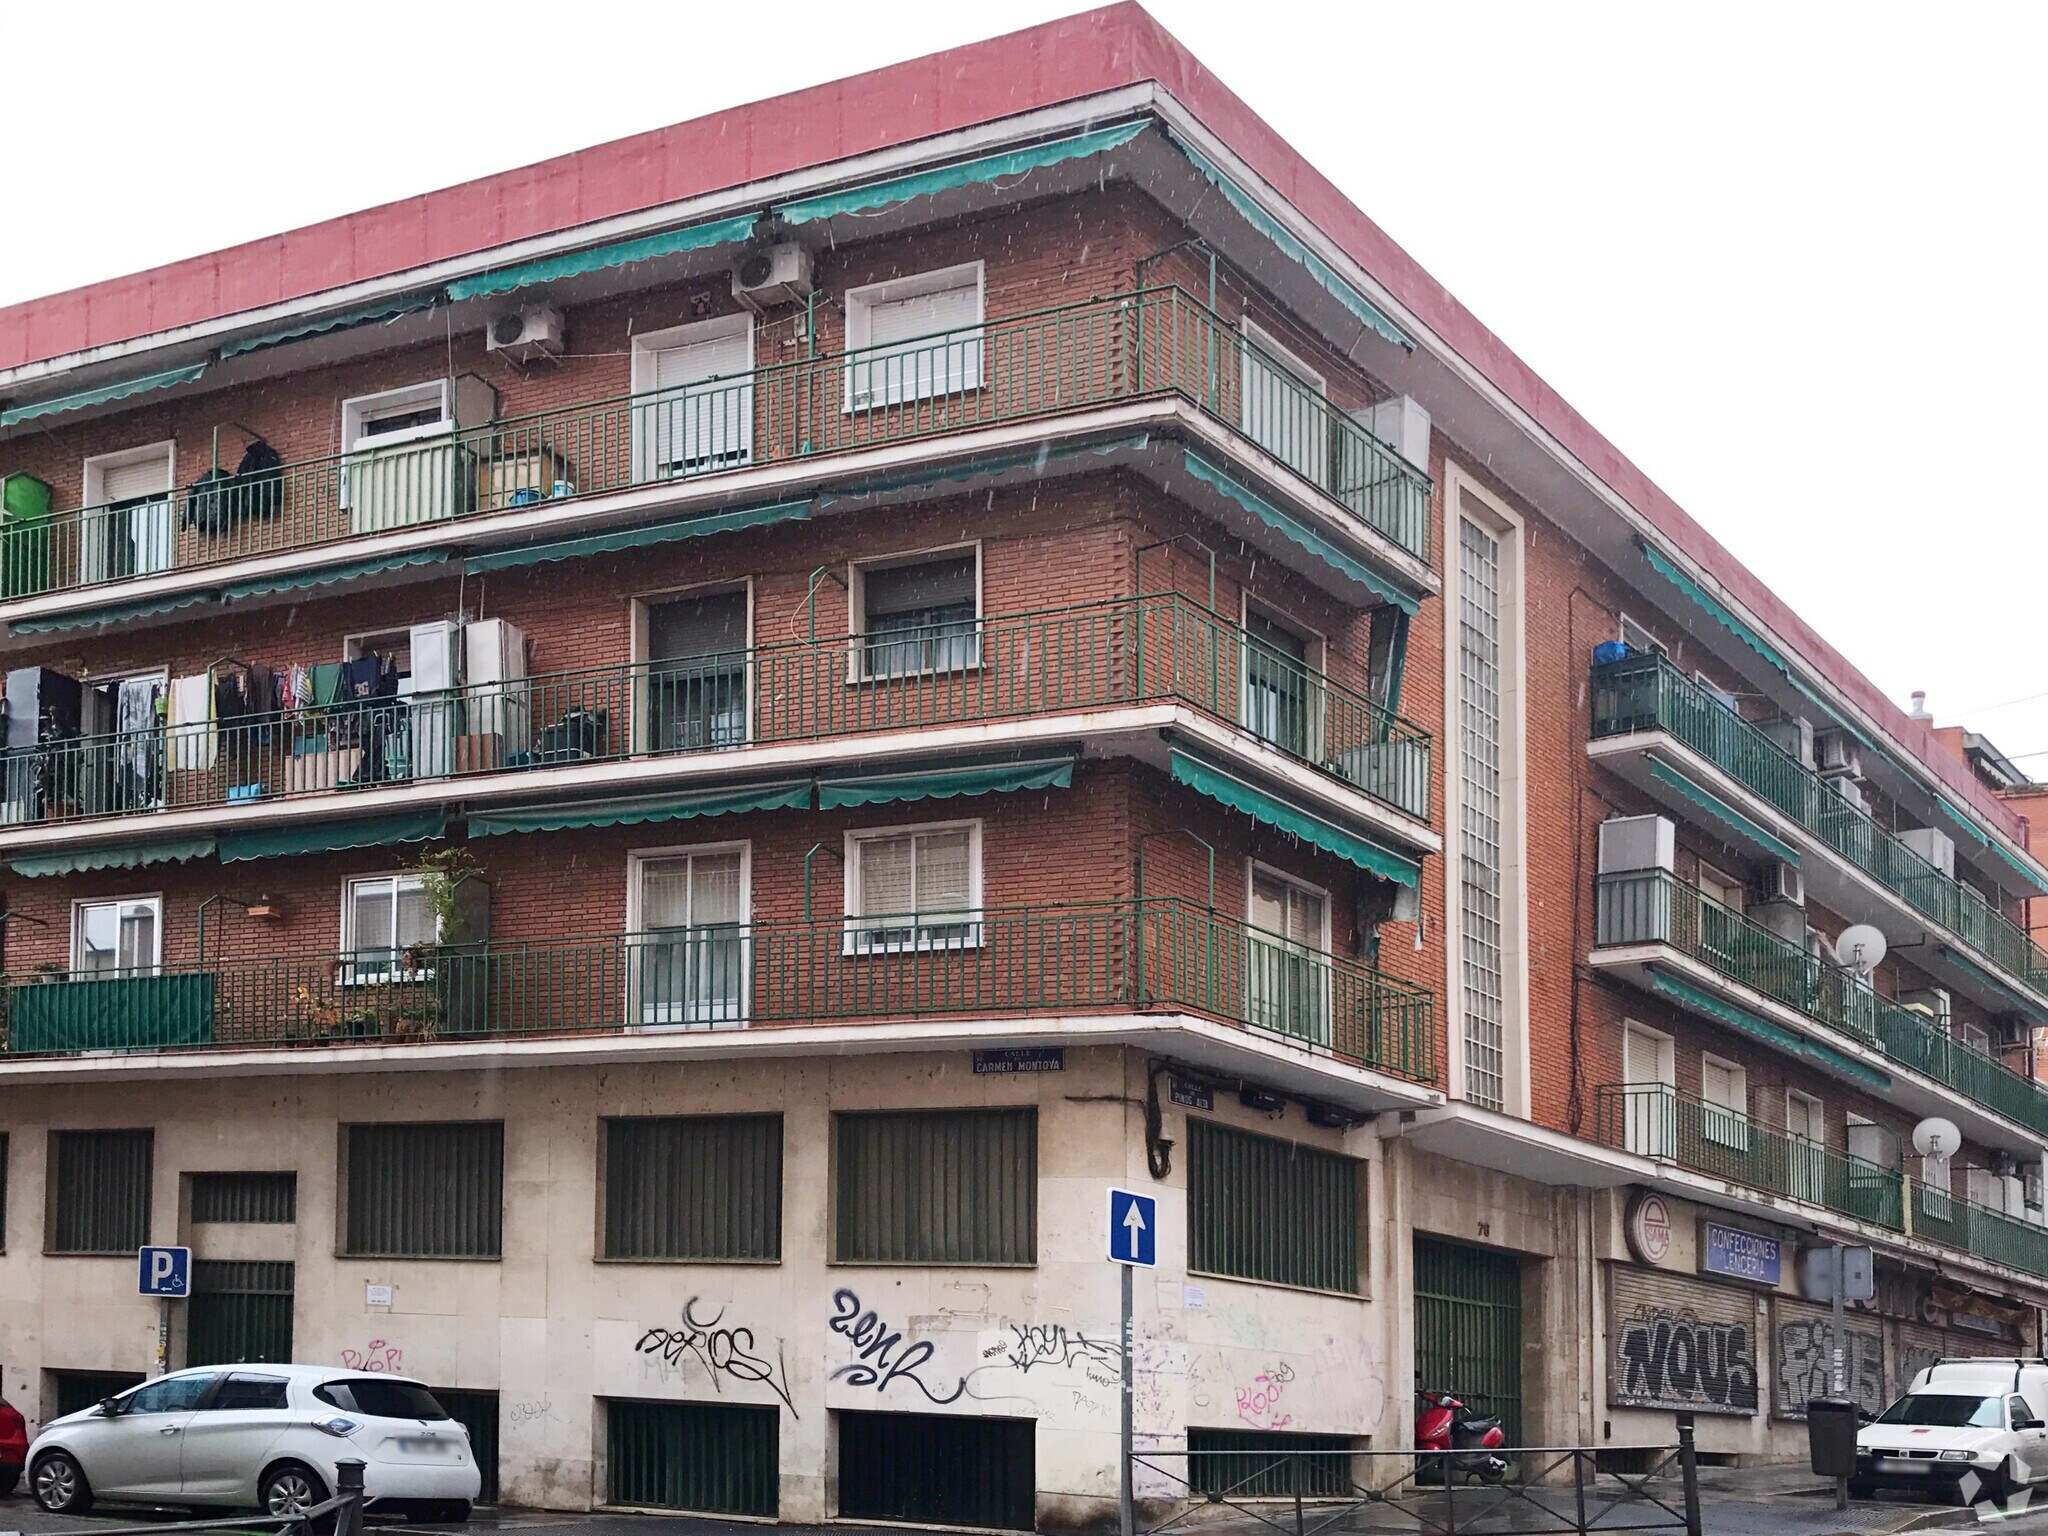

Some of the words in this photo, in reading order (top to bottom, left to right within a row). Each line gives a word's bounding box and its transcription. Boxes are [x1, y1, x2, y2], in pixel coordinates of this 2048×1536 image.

[976, 1061, 1013, 1073] CARMEN
[1018, 1060, 1060, 1071] MONTOYA
[1712, 1228, 1777, 1260] CONFECCIONES
[151, 1250, 174, 1290] P
